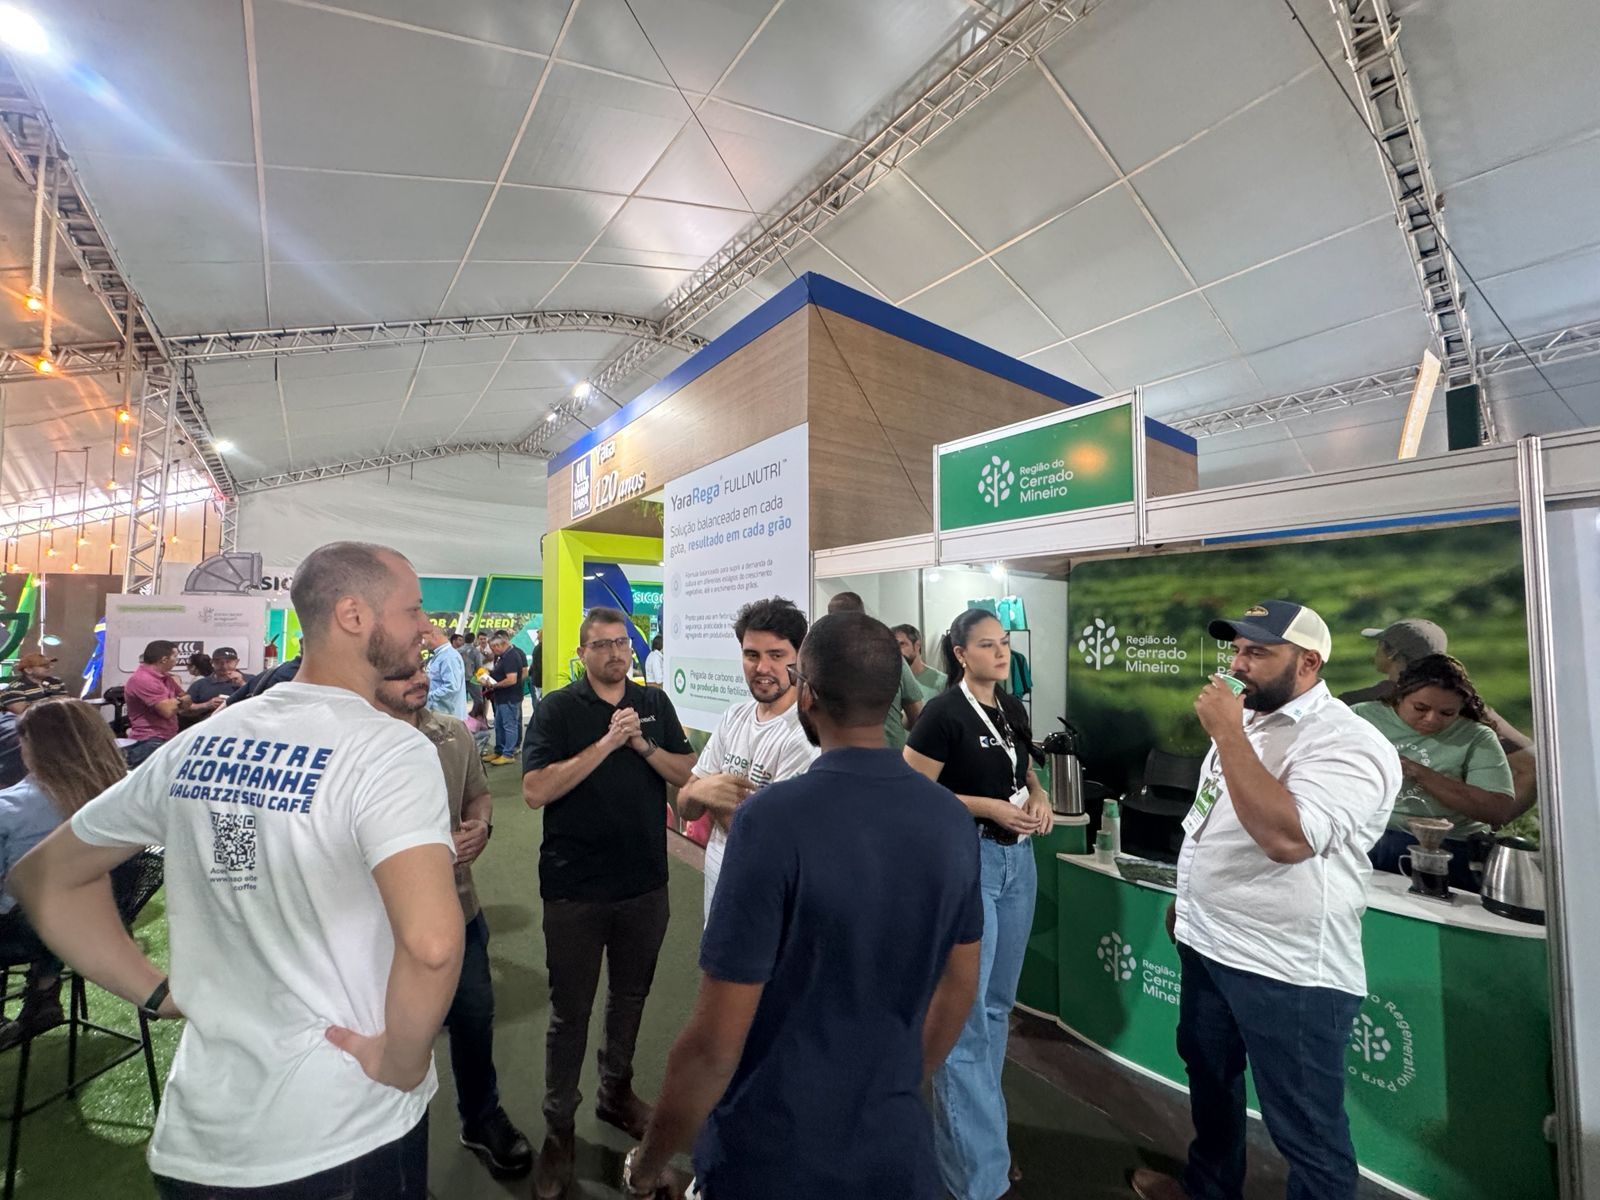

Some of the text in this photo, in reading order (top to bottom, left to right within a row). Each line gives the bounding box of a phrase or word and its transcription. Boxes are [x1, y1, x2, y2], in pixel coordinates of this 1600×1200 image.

[595, 440, 616, 464] Yara
[1020, 459, 1065, 476] Região do
[1020, 469, 1074, 489] Cerrado
[595, 470, 646, 509] 120 anos
[1020, 486, 1068, 504] Mineiro
[573, 495, 589, 512] YARA
[670, 495, 783, 539] Solução balanceada em cada
[670, 516, 792, 558] gota, resultado em cada grão
[1126, 635, 1178, 646] Região do
[1125, 646, 1187, 660] Cerrado
[708, 672, 714, 680] de
[715, 674, 734, 682] carbono
[1125, 660, 1180, 674] Mineiro
[697, 682, 718, 694] produção
[720, 686, 726, 694] do
[188, 736, 333, 770] REGISTRE
[176, 760, 322, 795] ACOMPANHE
[169, 783, 313, 814] VALORIZE SEU CAFÉ
[1142, 959, 1176, 978] Região
[1384, 1001, 1417, 1087] Regenerativo
[1362, 1072, 1398, 1092] Para
